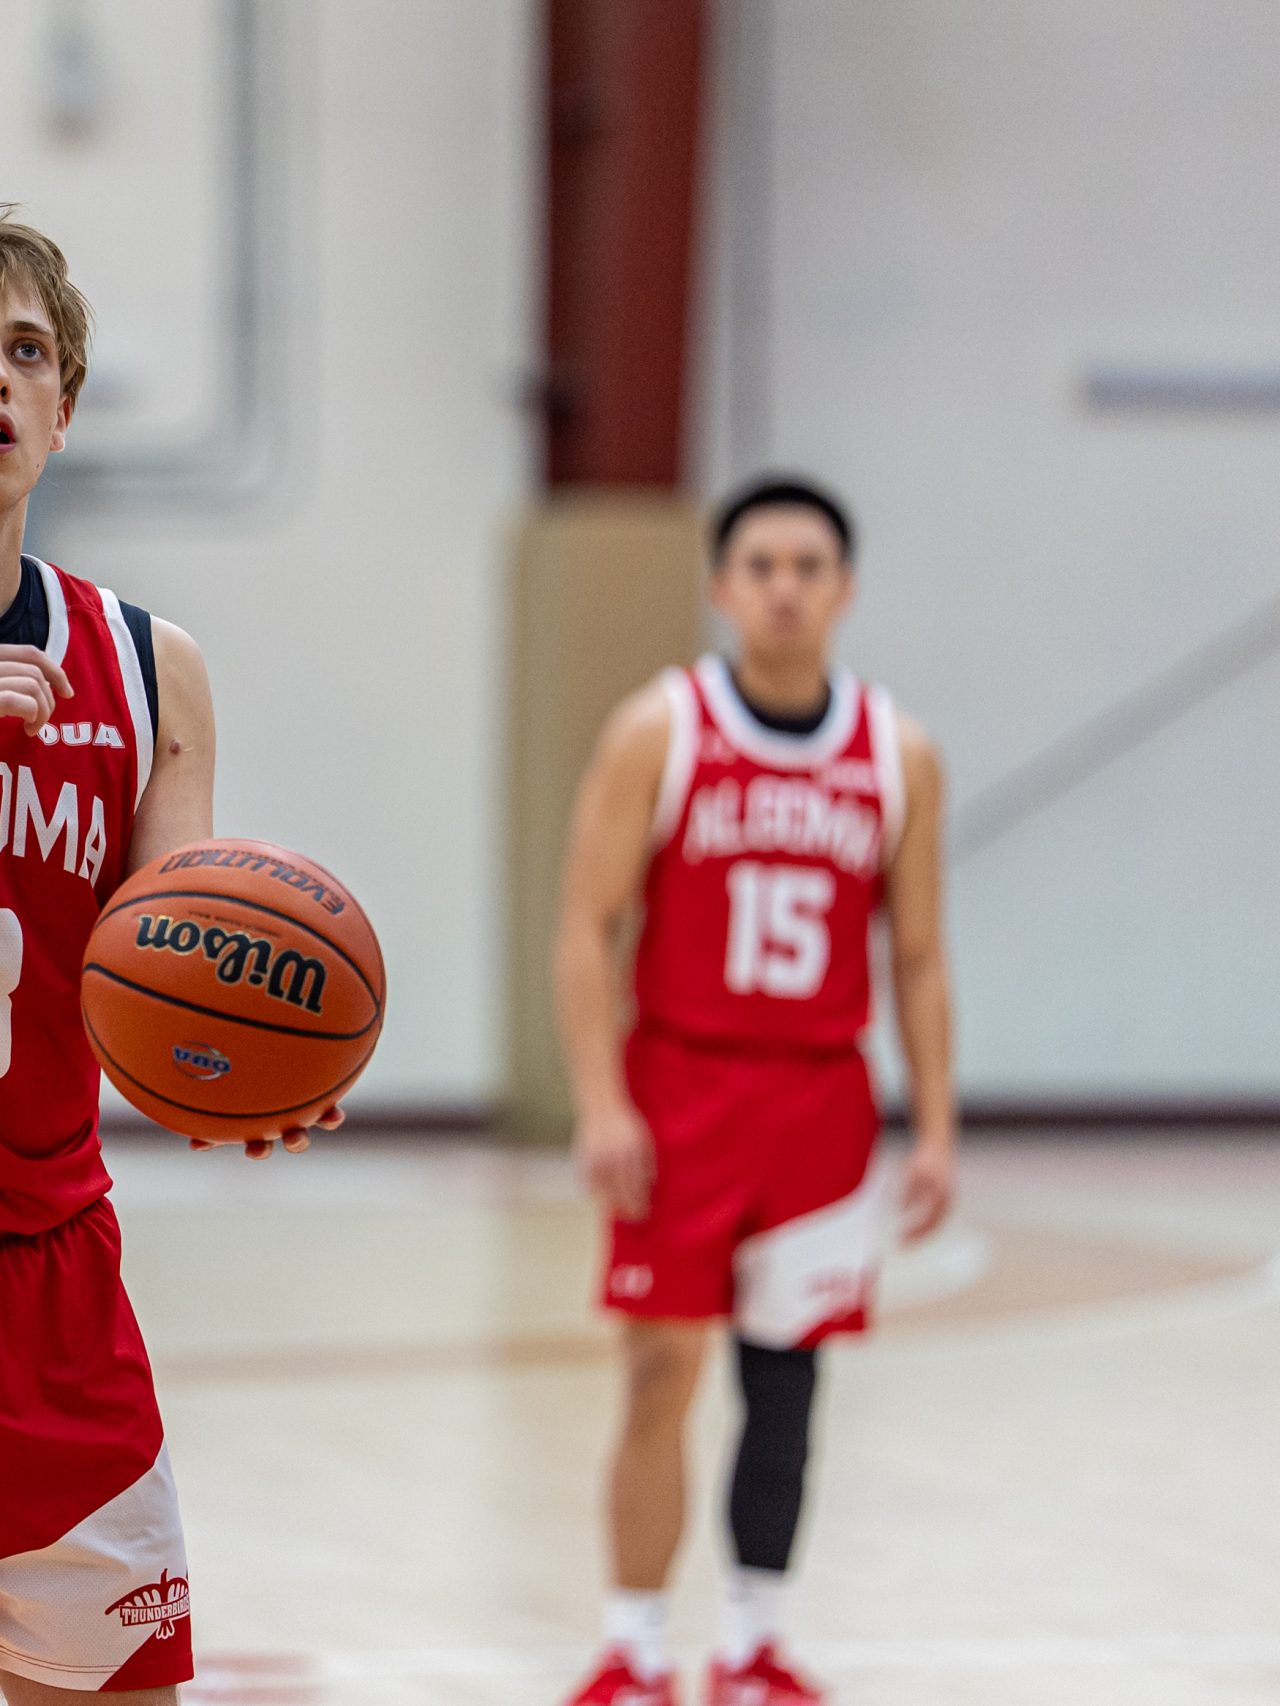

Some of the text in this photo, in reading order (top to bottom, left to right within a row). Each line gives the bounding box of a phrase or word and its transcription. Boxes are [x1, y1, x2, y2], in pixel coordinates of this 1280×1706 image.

[38, 721, 125, 748] OUA
[158, 849, 346, 916] EVOLUTION
[134, 914, 327, 1016] Wilson
[723, 859, 836, 1001] 15
